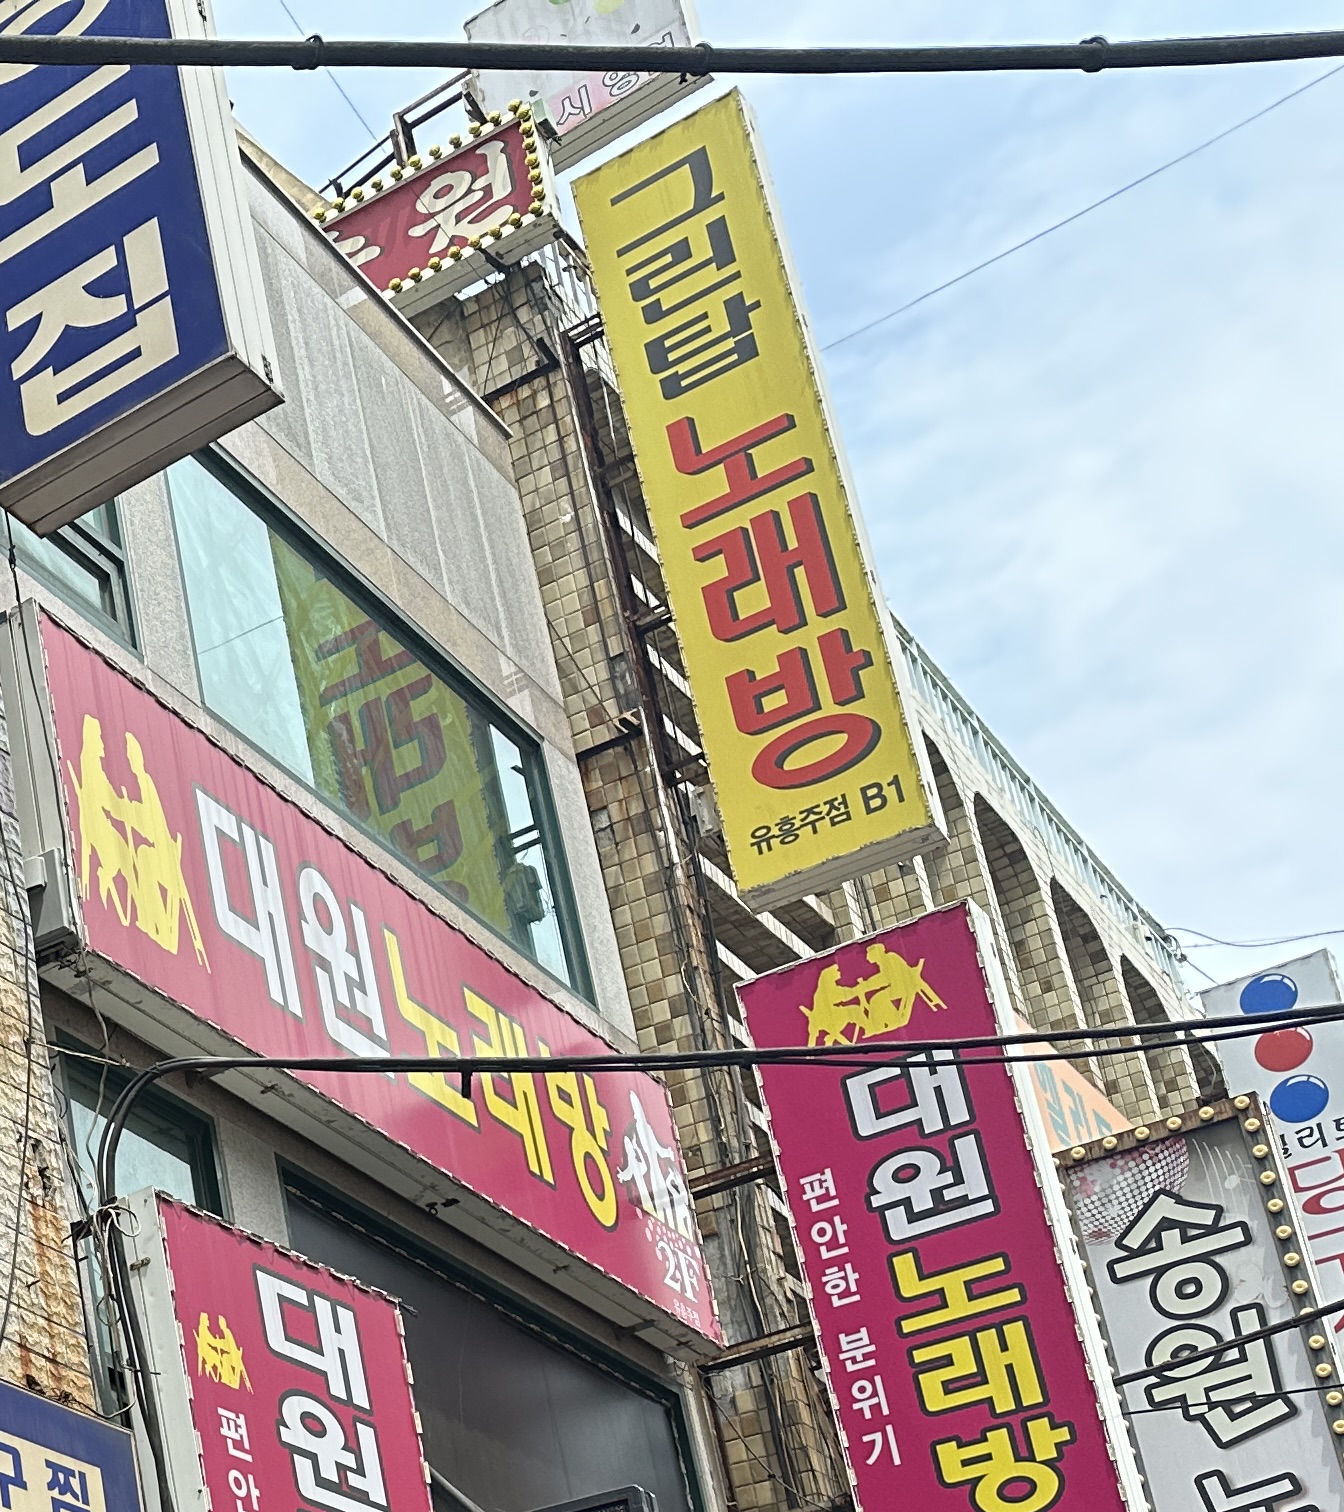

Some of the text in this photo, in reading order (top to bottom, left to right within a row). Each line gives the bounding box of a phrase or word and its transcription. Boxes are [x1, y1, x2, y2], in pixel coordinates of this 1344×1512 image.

[611, 145, 761, 400] 그린탑
[666, 413, 882, 790] 노래방
[749, 775, 905, 856] 유흥주점 B1
[657, 1240, 700, 1304] 2F
[800, 1167, 902, 1468] 편안한 분위기
[1108, 1190, 1301, 1450] 송원
